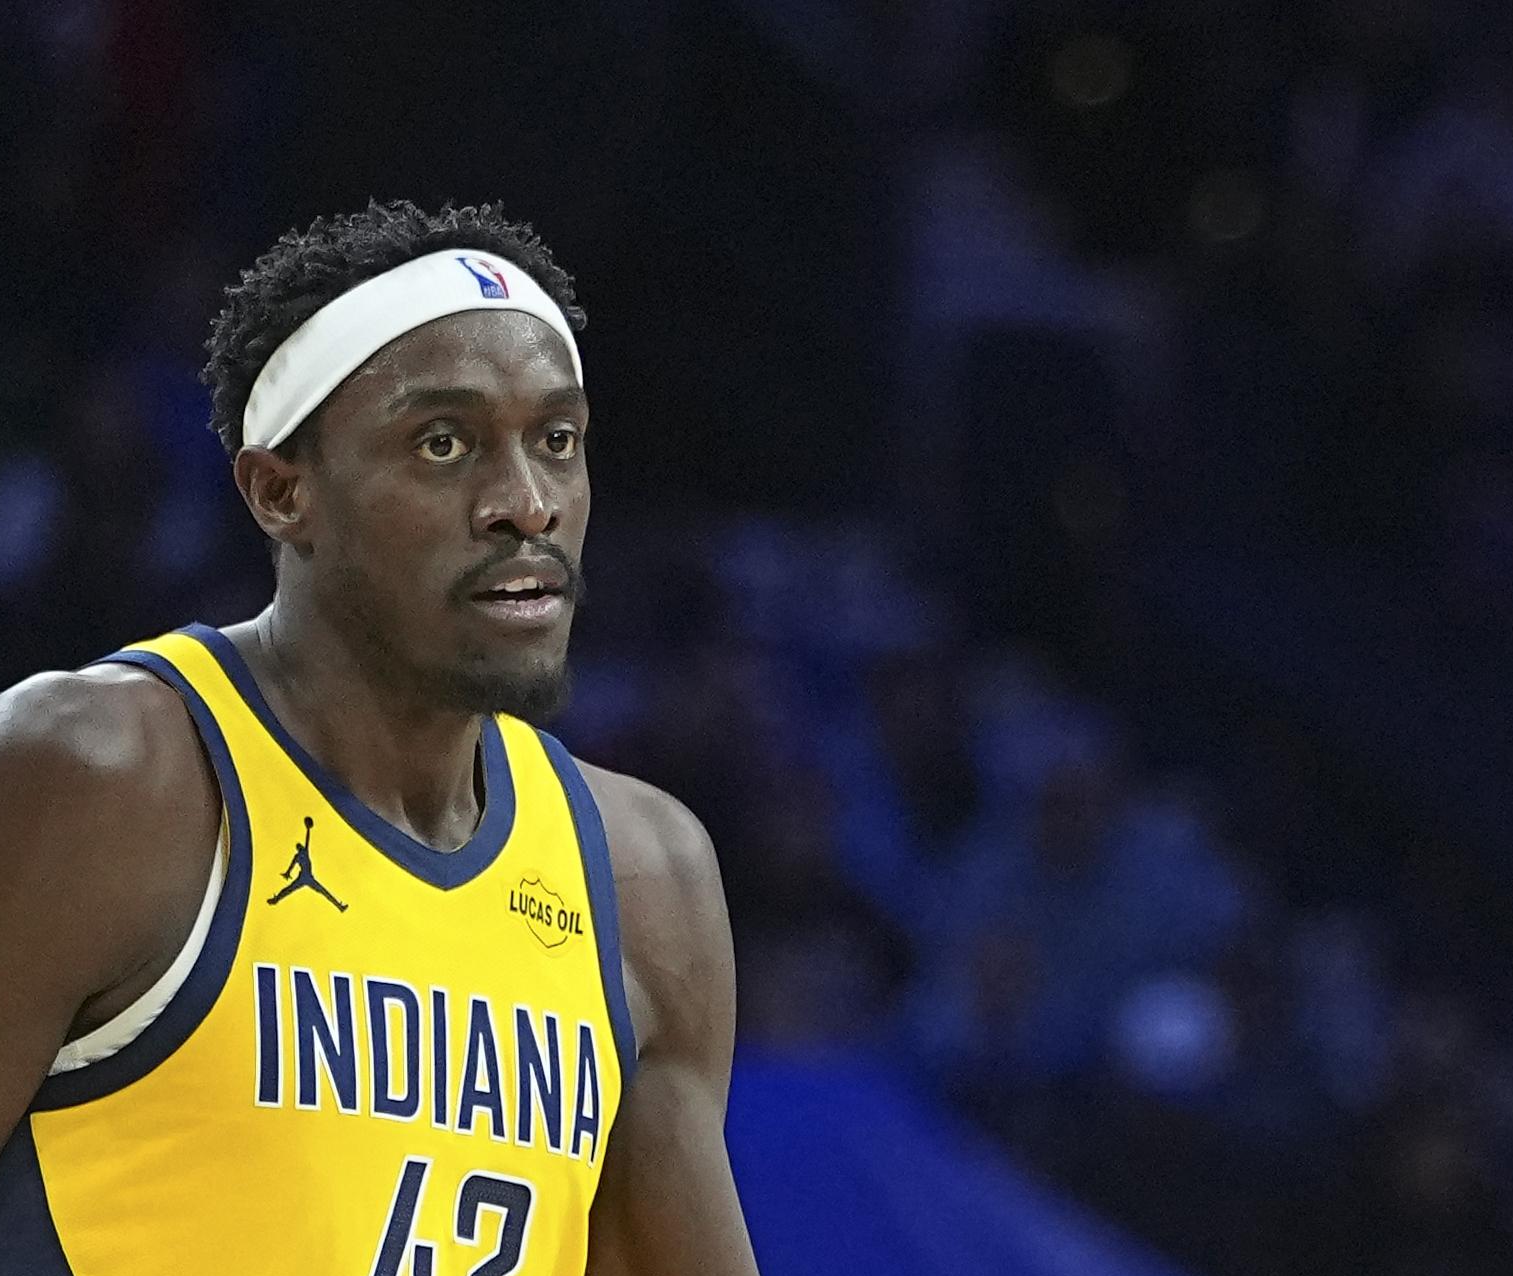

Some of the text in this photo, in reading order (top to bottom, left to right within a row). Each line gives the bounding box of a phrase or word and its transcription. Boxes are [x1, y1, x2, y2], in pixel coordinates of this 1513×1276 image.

[509, 889, 584, 935] LUCAS OIL
[252, 962, 603, 1168] INDIANA
